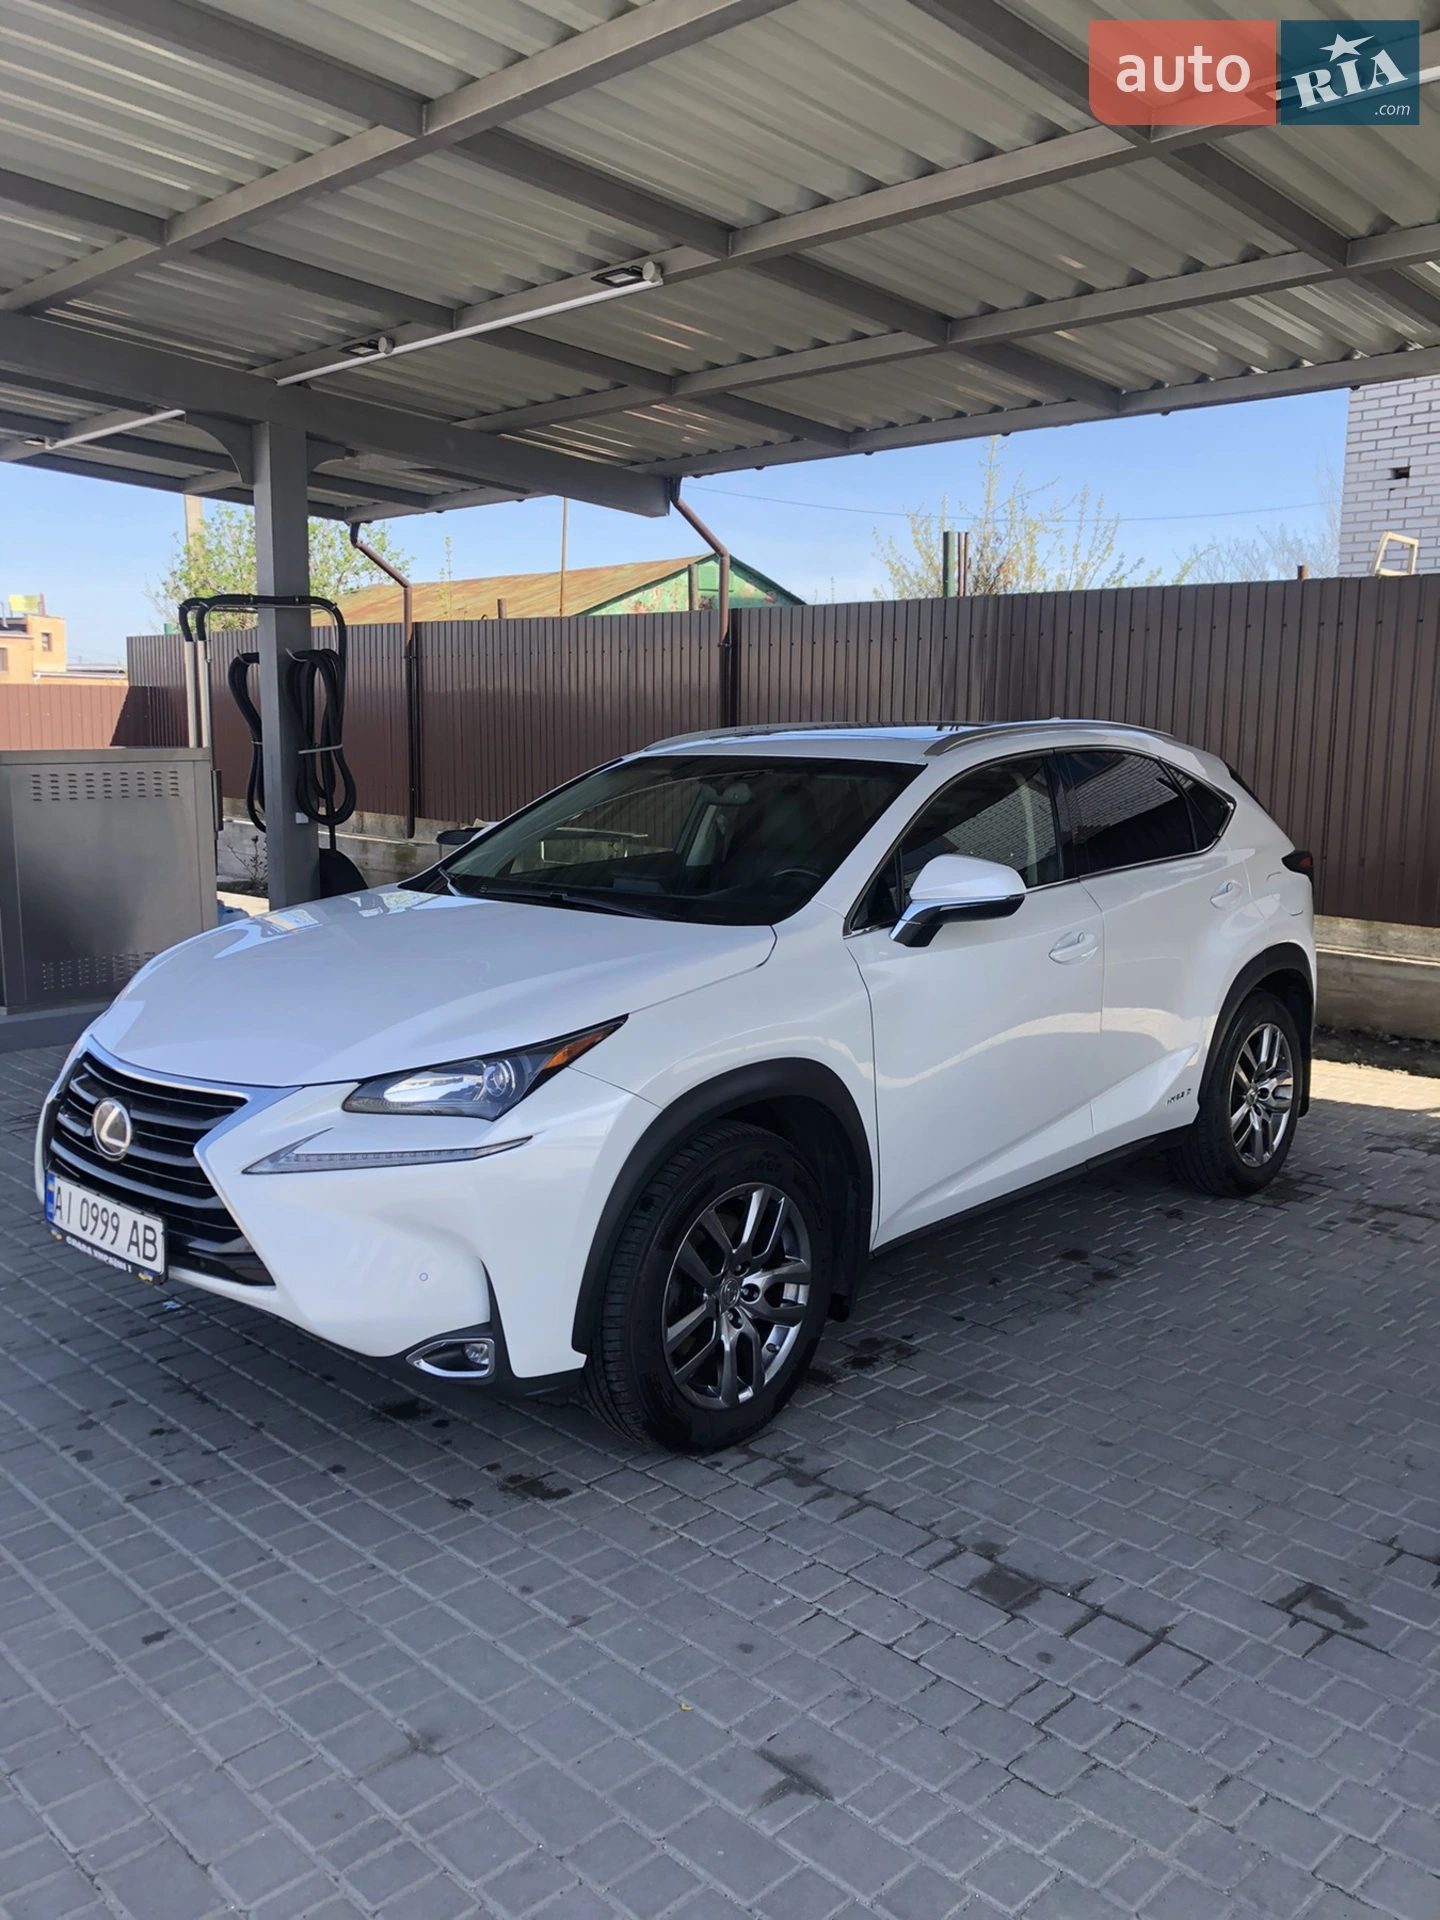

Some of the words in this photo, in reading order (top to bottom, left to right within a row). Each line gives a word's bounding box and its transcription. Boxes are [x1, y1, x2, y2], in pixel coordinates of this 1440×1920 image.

[54, 1186, 72, 1225] AI
[79, 1197, 120, 1246] 0999
[126, 1220, 158, 1263] AB
